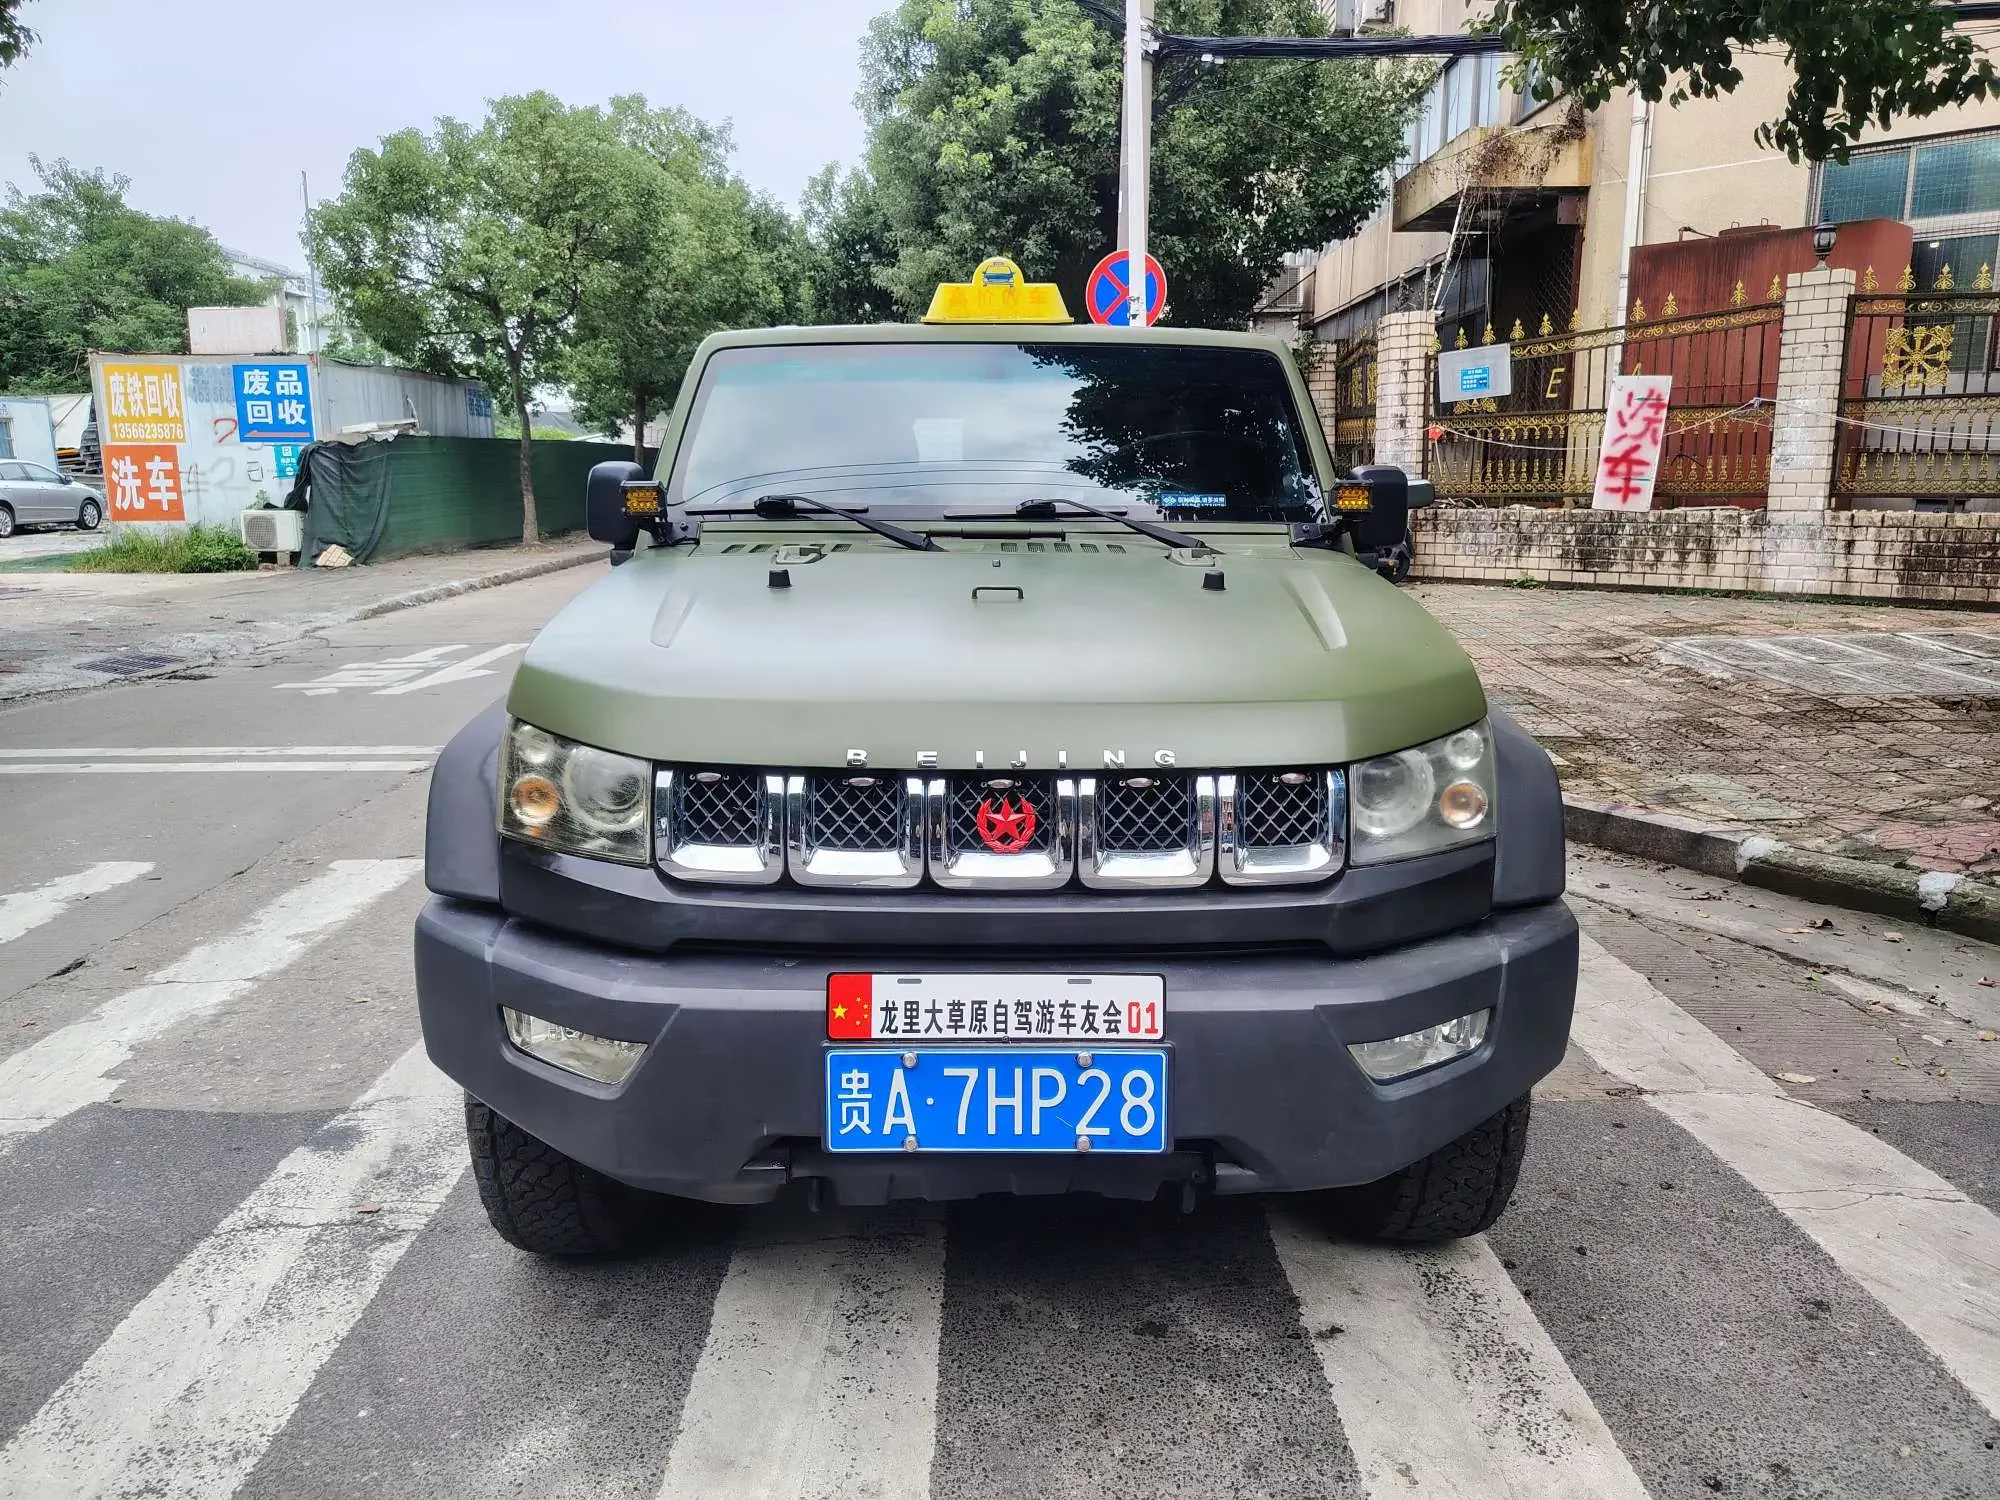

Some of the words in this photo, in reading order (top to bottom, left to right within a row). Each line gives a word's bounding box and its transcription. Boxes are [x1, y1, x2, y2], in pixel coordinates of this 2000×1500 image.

[108, 372, 180, 418] 废铁回收
[243, 369, 303, 396] 废品
[246, 399, 307, 425] 回收
[113, 422, 184, 439] 13566235876
[1604, 388, 1669, 504] 洗车
[111, 455, 179, 511] 洗车
[846, 749, 1177, 769] BEIJING
[879, 999, 1159, 1035] 龙里大草原自驾游车友会01
[837, 1068, 1156, 1137] 贵A·7HP28
